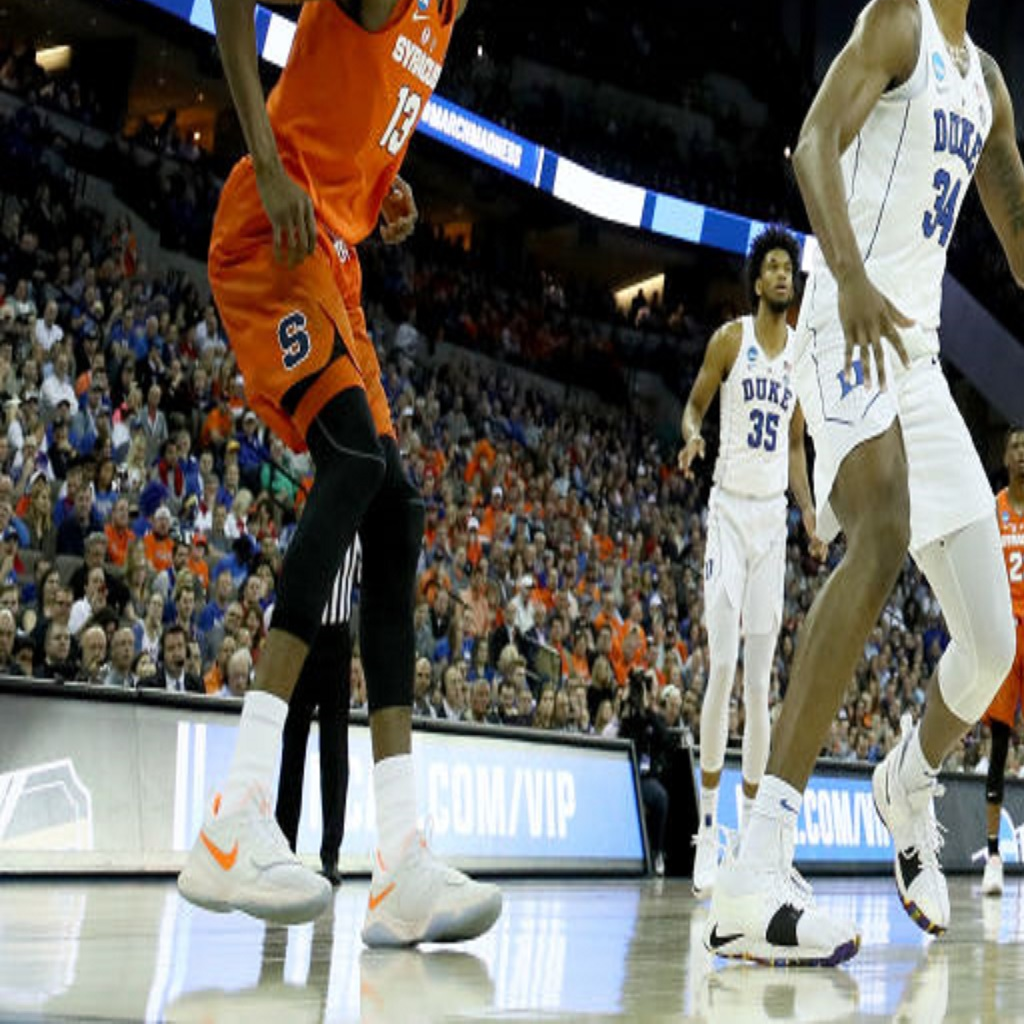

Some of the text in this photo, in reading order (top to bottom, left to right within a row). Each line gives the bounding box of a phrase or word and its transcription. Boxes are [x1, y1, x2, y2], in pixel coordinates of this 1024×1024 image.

[379, 86, 422, 156] 13
[933, 107, 983, 175] DUKE
[921, 167, 962, 248] 34
[277, 309, 311, 371] S
[742, 378, 793, 412] DUKE
[747, 408, 780, 452] 35
